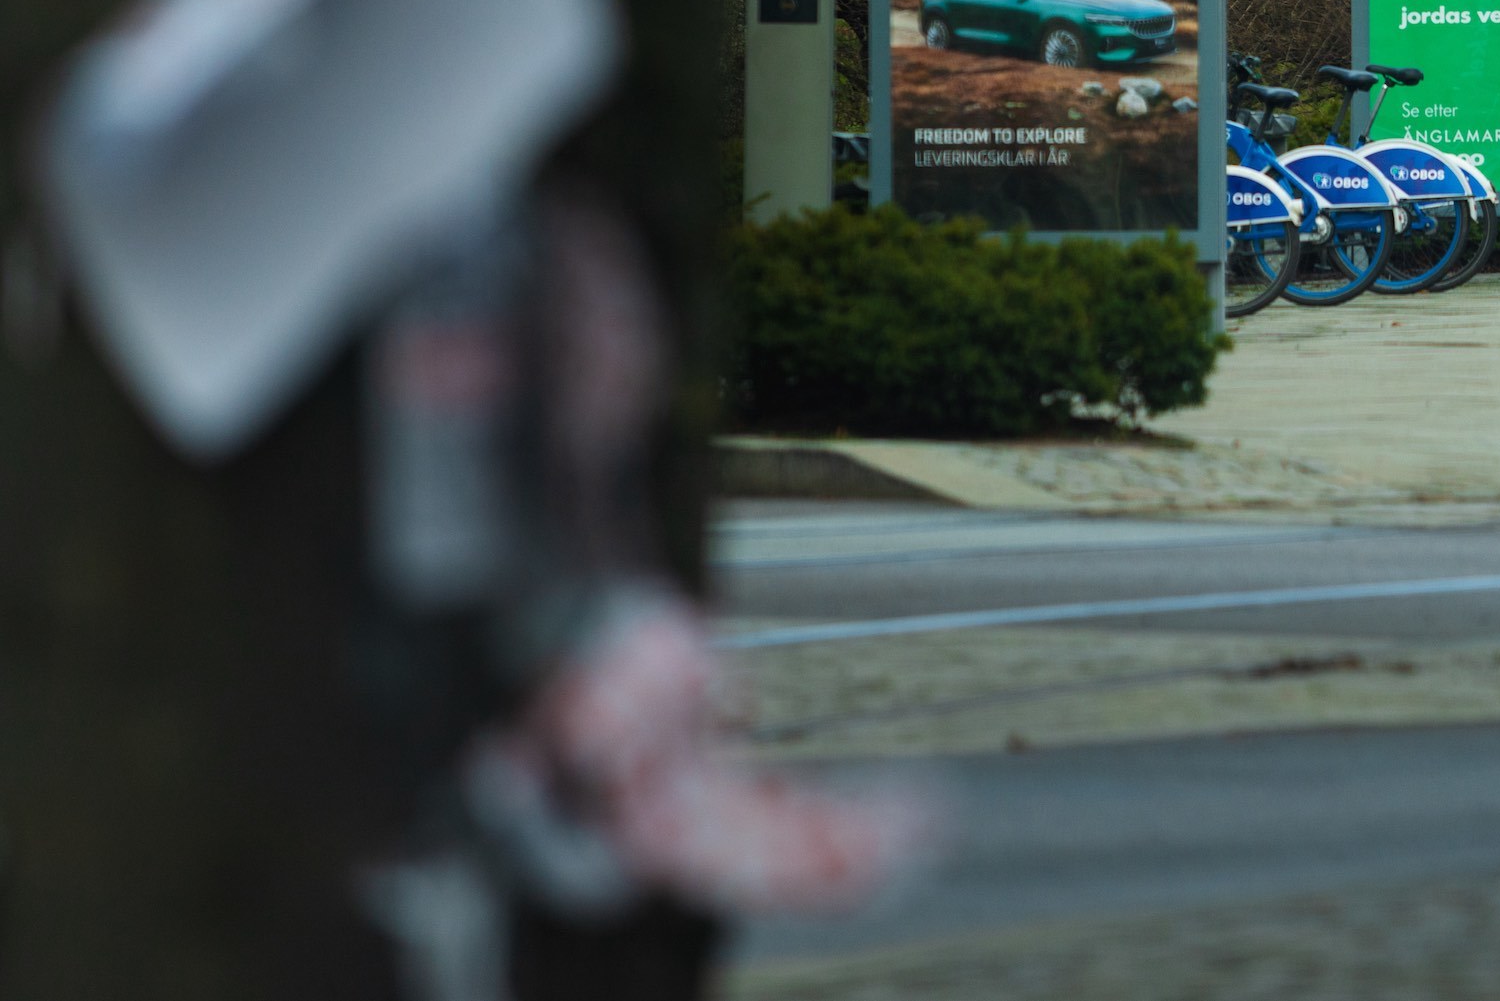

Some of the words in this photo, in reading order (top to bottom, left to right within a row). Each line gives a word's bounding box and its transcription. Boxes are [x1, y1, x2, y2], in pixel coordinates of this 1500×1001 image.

[1399, 6, 1471, 29] jordas
[1402, 102, 1419, 118] Se
[1424, 103, 1458, 117] etter
[914, 128, 988, 144] FREEDOM
[993, 127, 1014, 144] TO
[1016, 127, 1087, 144] EXPLORE
[914, 149, 1035, 167] LEVERINGSKLAR
[1047, 145, 1071, 166] ÅR
[1333, 176, 1369, 189] OBOS
[1410, 169, 1445, 181] OBOS
[1232, 191, 1272, 206] OBOS
